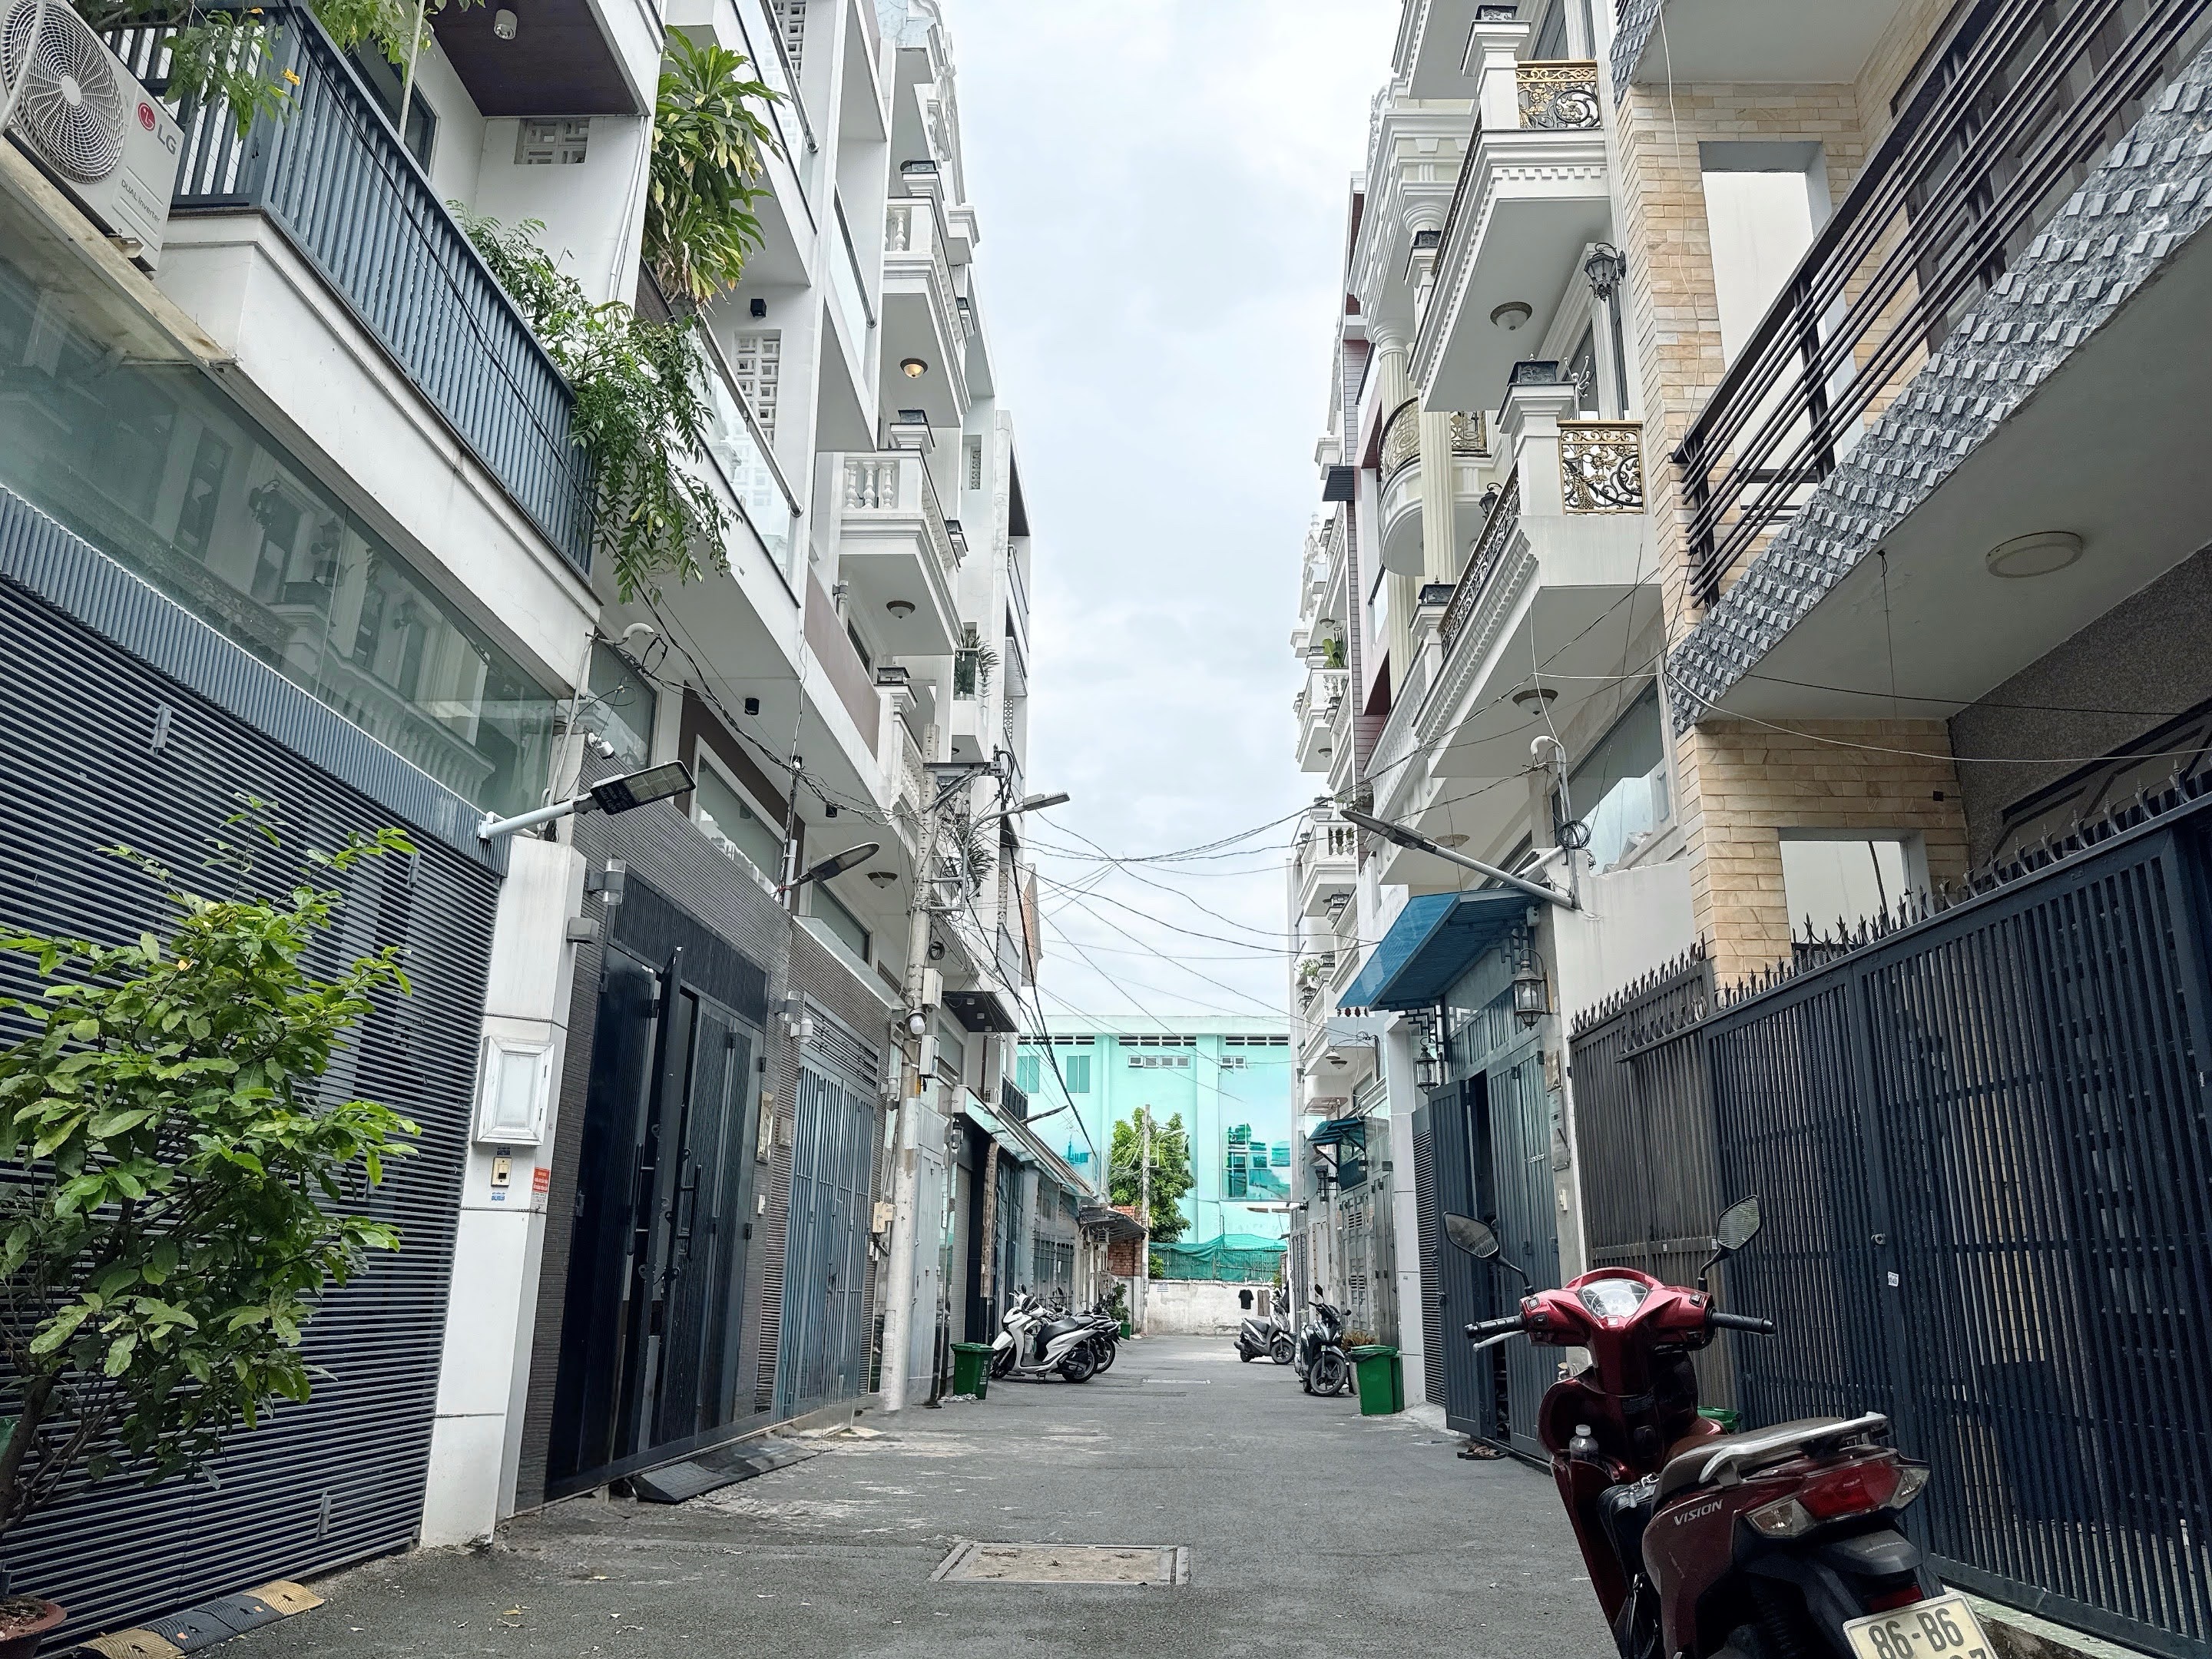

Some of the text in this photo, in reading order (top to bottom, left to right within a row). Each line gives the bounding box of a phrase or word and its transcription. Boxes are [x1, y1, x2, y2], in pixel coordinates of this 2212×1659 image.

[157, 123, 177, 155] LG
[121, 179, 138, 201] DUAL
[1674, 1498, 1724, 1526] VISION
[1868, 1608, 1965, 1659] 86-B6
